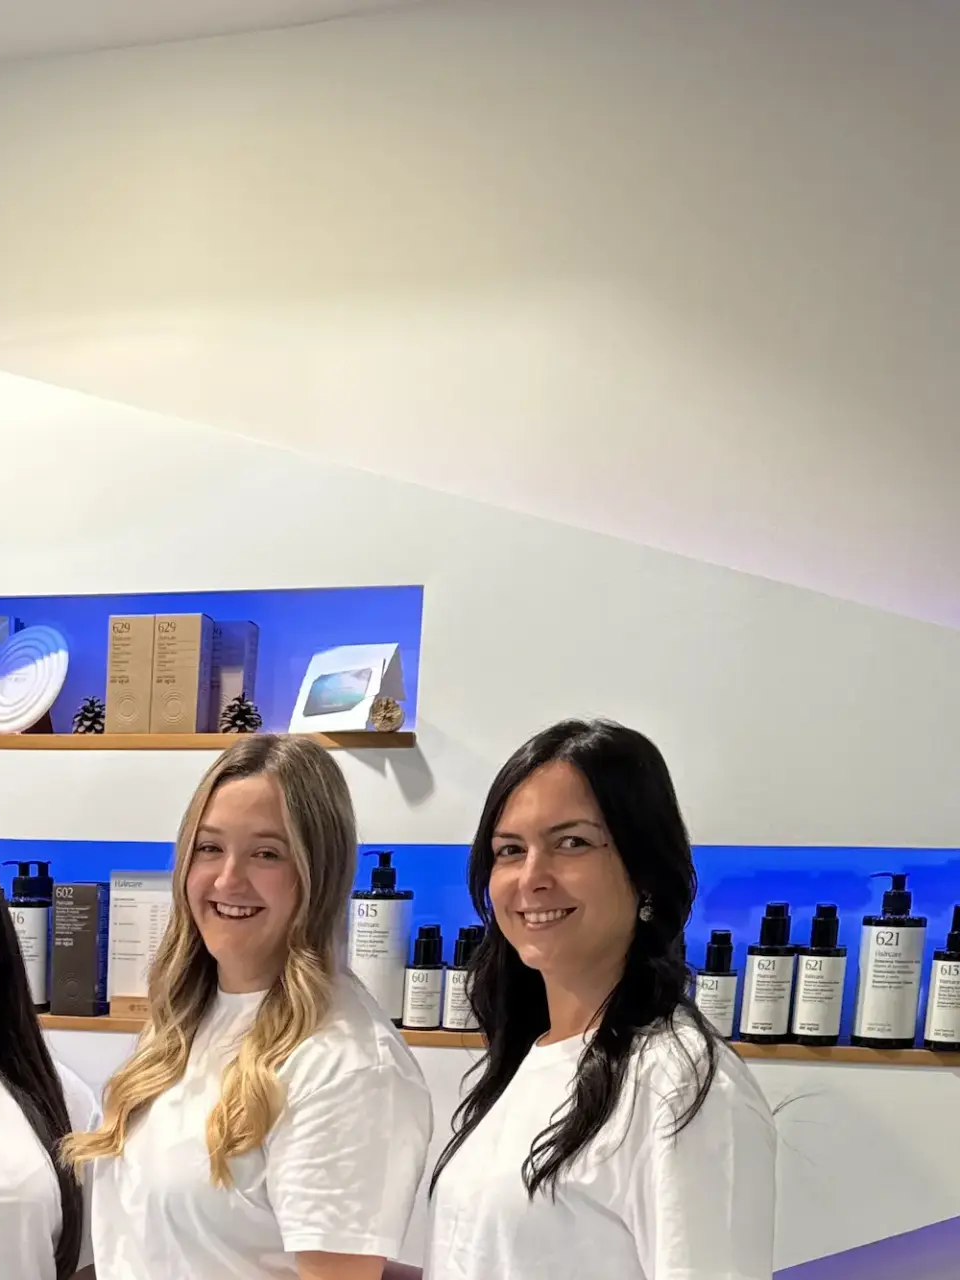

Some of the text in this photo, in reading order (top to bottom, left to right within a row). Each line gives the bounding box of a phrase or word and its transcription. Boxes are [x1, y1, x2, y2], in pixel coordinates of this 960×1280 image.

[112, 622, 130, 634] 629
[158, 621, 176, 633] 629
[55, 887, 74, 898] 602
[357, 904, 378, 917] 615
[876, 931, 900, 946] 621
[757, 960, 776, 971] 621
[805, 960, 823, 971] 621
[412, 972, 429, 982] 601
[701, 979, 719, 990] 621
